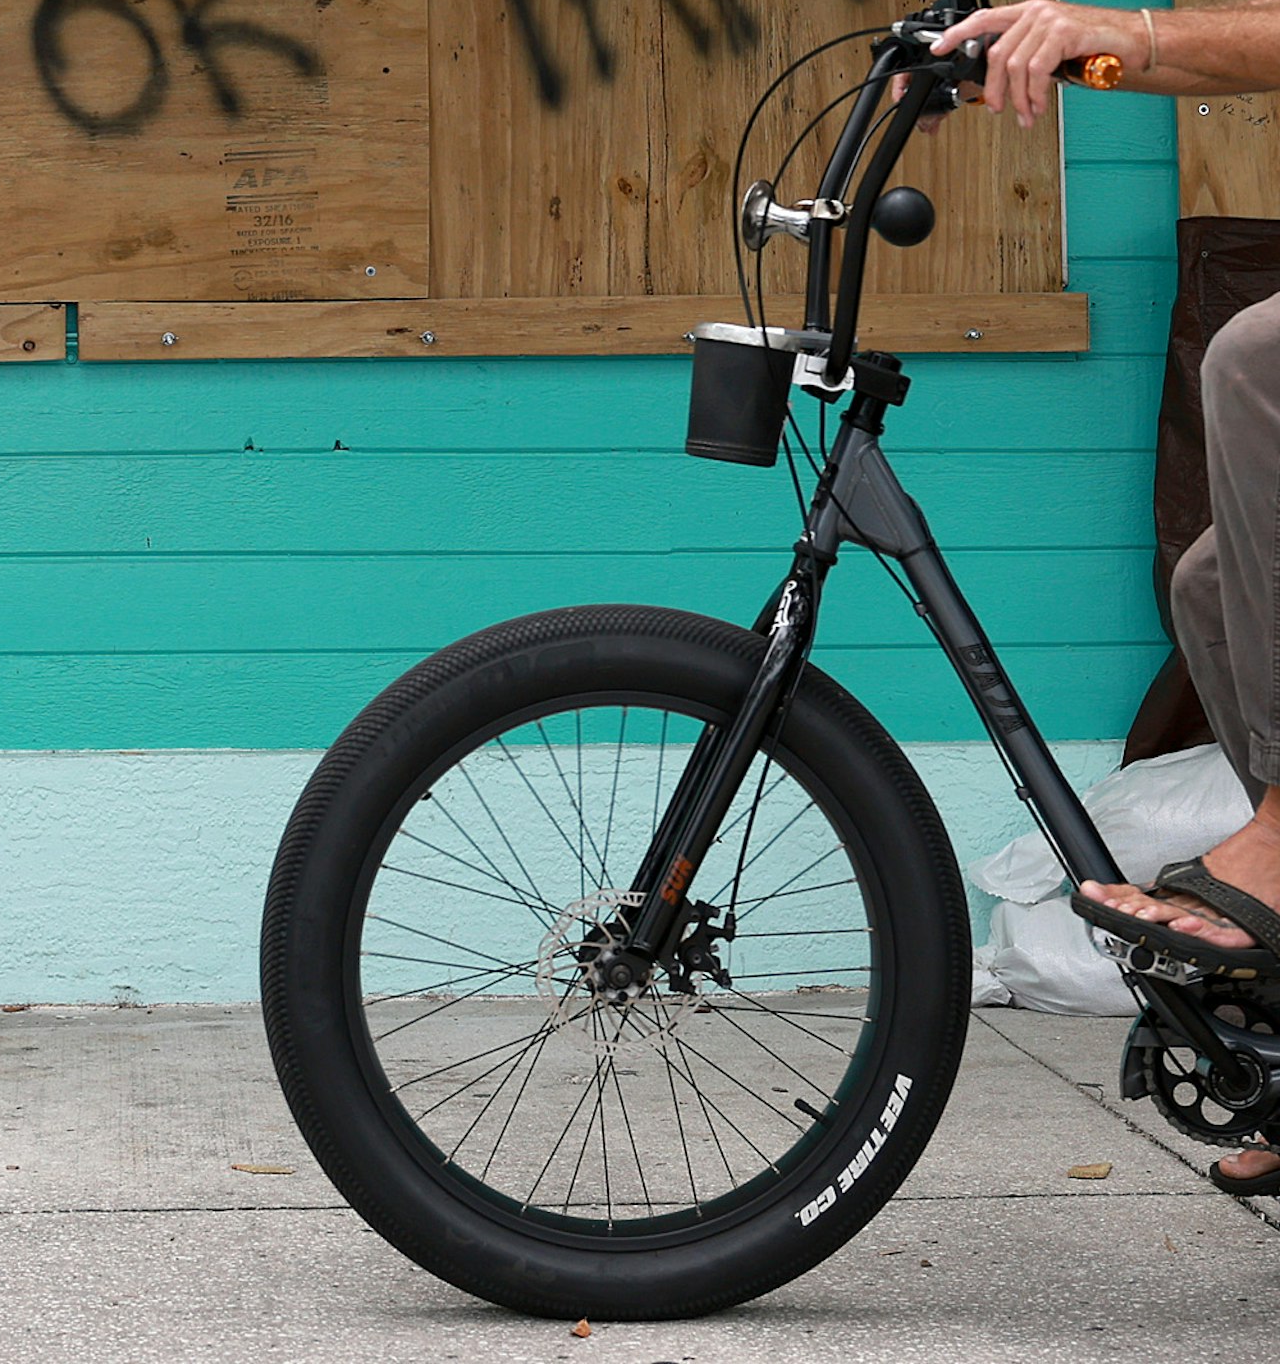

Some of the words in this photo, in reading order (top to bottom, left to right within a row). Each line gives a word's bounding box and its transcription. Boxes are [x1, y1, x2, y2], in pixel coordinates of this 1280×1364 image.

[253, 215, 294, 228] 32/16
[958, 643, 1027, 735] BAJA
[879, 1073, 914, 1134] VEE
[839, 1126, 888, 1194] TIRE
[794, 1185, 838, 1228] CO.
